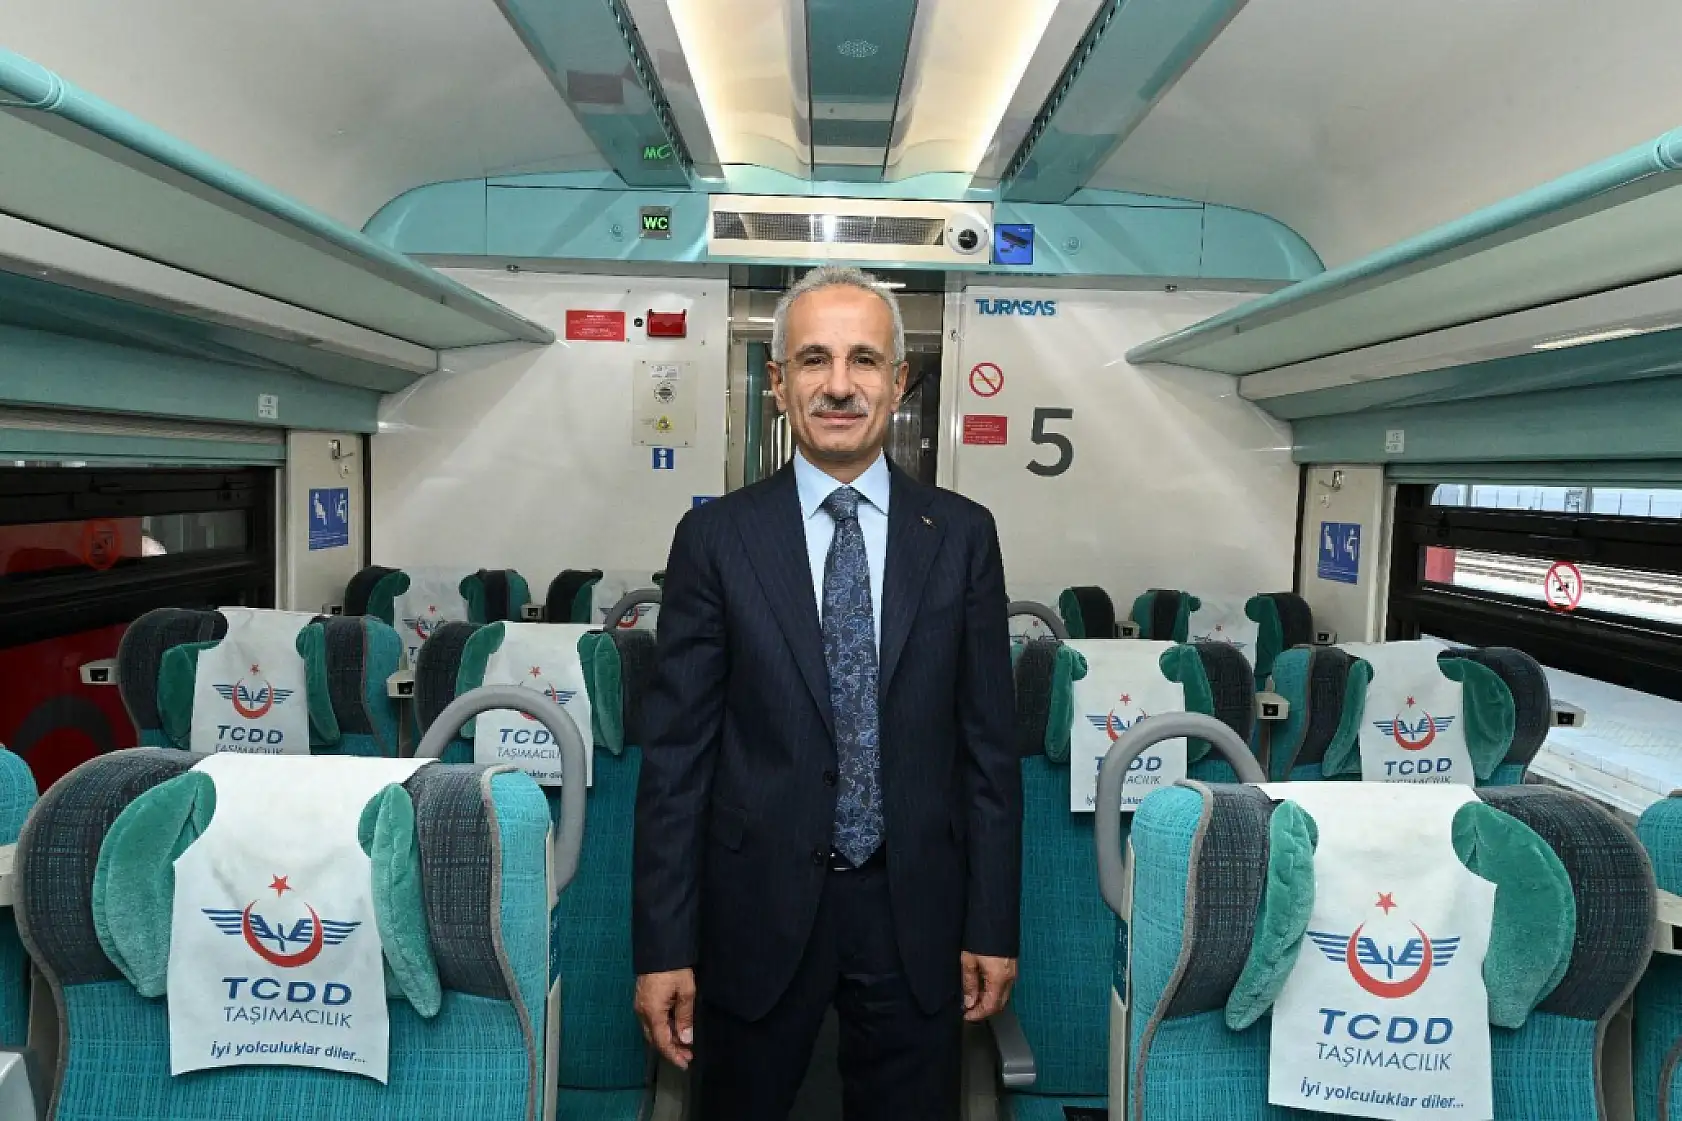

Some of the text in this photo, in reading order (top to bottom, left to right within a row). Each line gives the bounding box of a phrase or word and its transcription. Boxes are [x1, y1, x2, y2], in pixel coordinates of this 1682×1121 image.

[643, 216, 668, 230] WC
[1026, 407, 1074, 477] 5
[217, 725, 284, 744] TCDD
[499, 728, 557, 745] TCD
[1095, 756, 1162, 771] TDD
[1384, 757, 1452, 776] TCDD
[222, 977, 352, 1006] TCDD
[223, 1006, 353, 1028] TAŞIMACILIK
[1319, 1008, 1454, 1044] TCDD
[235, 1041, 321, 1057] yolculuklar
[324, 1045, 367, 1063] diler...
[1316, 1042, 1452, 1071] TAŞIMACILIK
[1324, 1085, 1417, 1107] yolculuklar
[1421, 1094, 1464, 1109] diler...
